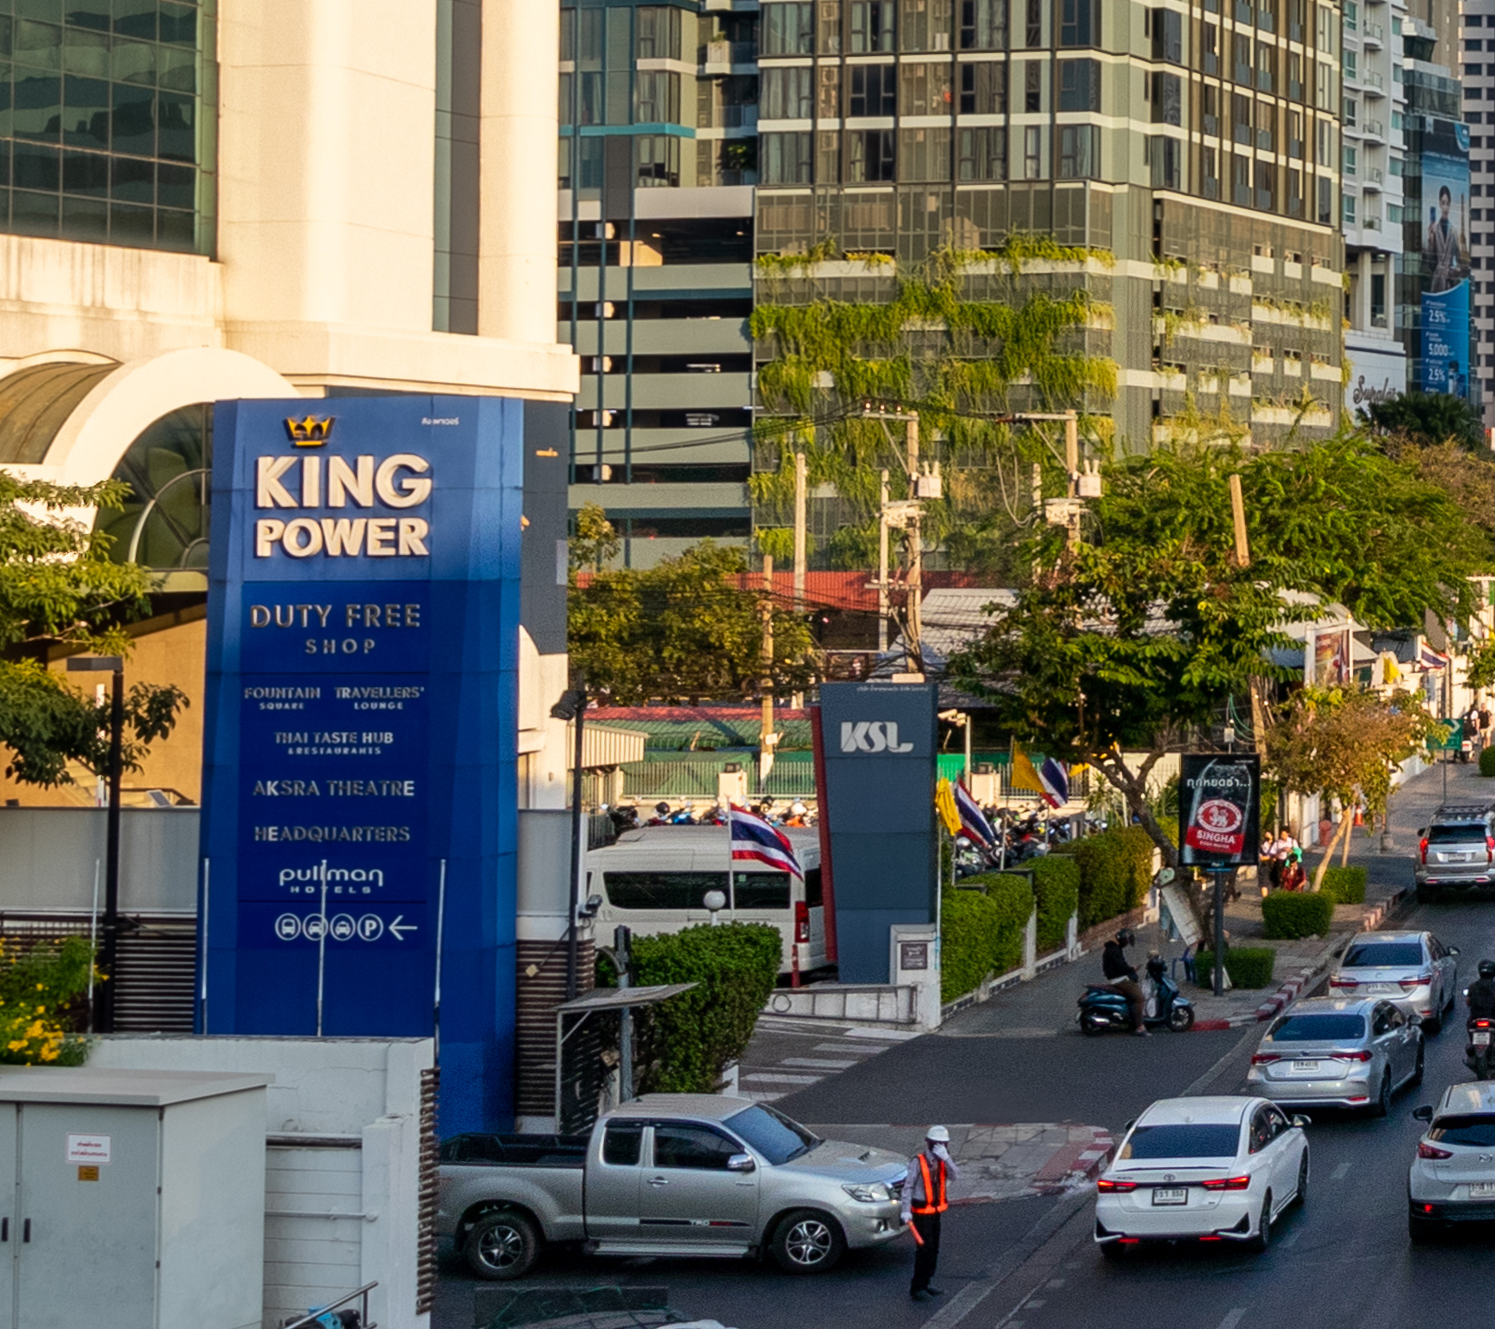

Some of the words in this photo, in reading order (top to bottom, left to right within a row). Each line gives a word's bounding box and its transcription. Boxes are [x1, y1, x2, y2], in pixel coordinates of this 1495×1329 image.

[255, 454, 432, 509] KING
[255, 517, 430, 559] POWER
[250, 604, 333, 629] DUTY
[346, 604, 422, 629] FREE
[305, 638, 377, 655] SHOP
[244, 687, 321, 699] FOUNTAIN
[259, 702, 305, 710] SQUARE
[354, 702, 404, 710] LOUNGE
[275, 732, 308, 744] THAI
[313, 732, 357, 744] TASTE
[362, 732, 394, 744] HUB
[840, 722, 914, 753] KSL
[254, 780, 320, 796] AKSRA
[327, 780, 414, 796] THEATRE
[255, 826, 410, 842] HEADQUARTERS
[1196, 829, 1236, 844] SINGHA
[279, 865, 383, 887] pullman
